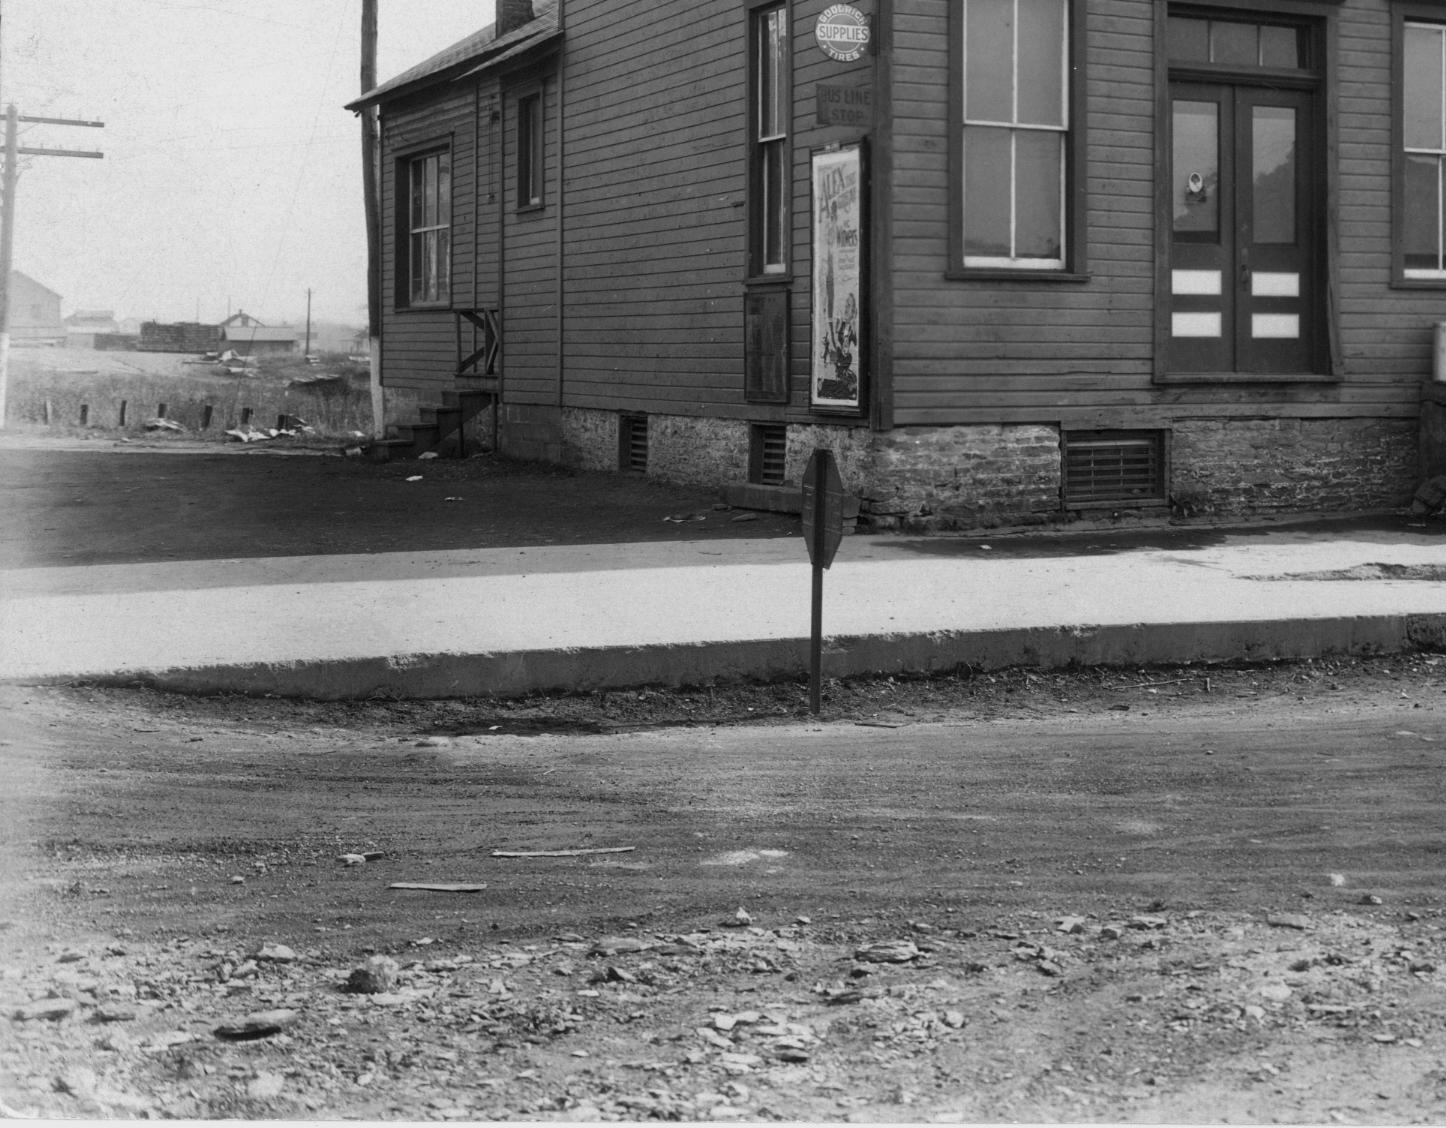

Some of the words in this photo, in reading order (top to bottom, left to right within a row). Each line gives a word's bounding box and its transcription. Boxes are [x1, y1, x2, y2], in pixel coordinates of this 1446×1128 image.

[818, 3, 865, 25] GOODRICH
[819, 25, 869, 41] SUPPLIES
[828, 48, 861, 62] TIRES
[843, 88, 872, 106] LINE
[831, 108, 865, 123] STOP
